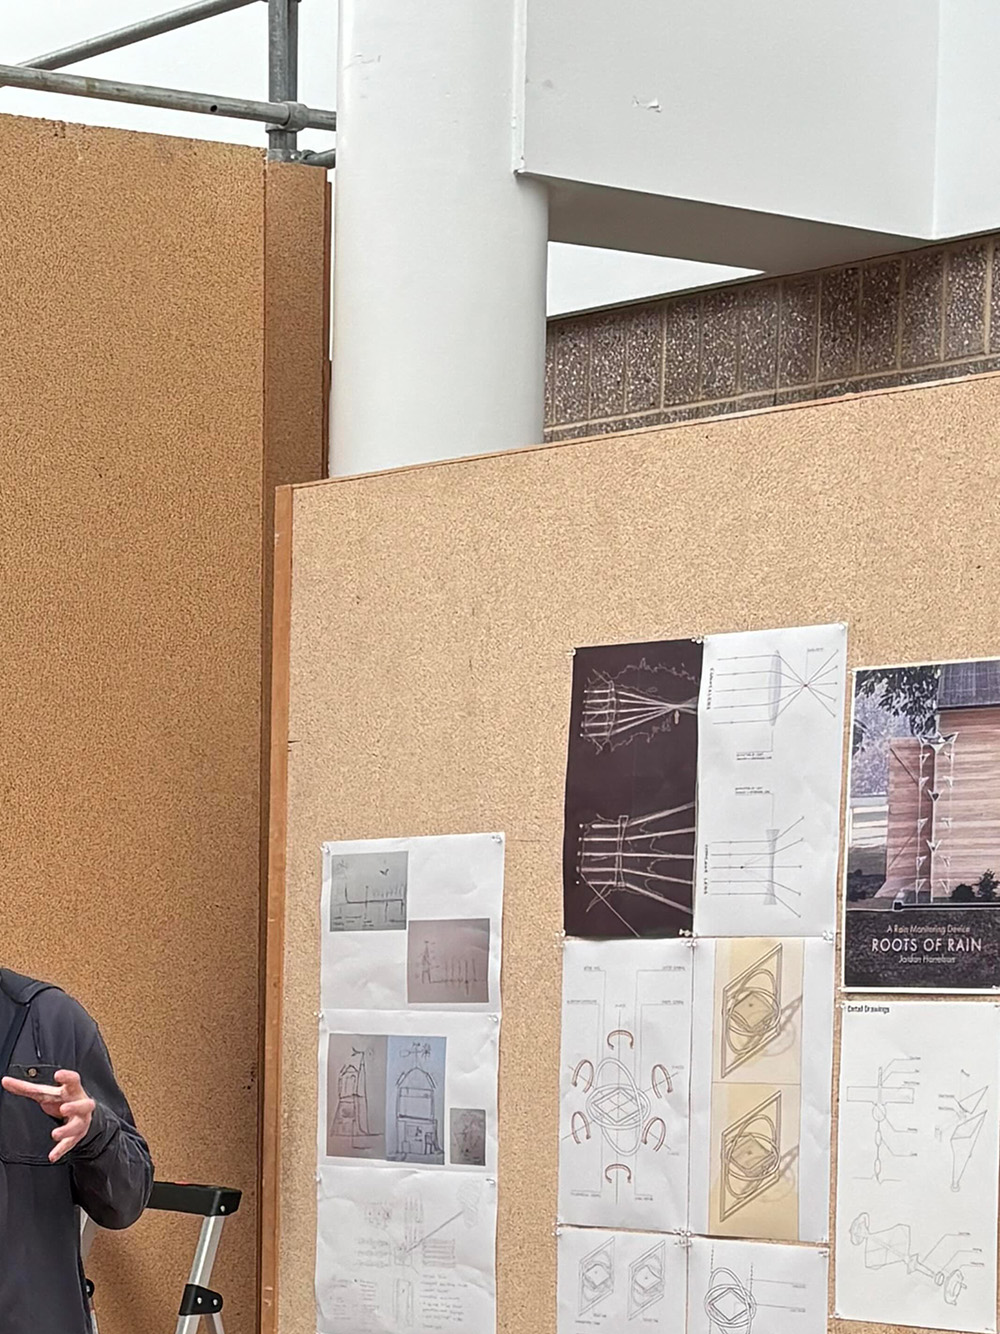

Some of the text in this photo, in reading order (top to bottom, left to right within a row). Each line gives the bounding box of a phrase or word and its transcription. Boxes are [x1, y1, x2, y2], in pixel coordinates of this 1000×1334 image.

[886, 925, 893, 933] A
[910, 925, 946, 936] Monitoring
[947, 924, 971, 933] Device
[871, 938, 982, 952] ROOTS OF RAIN
